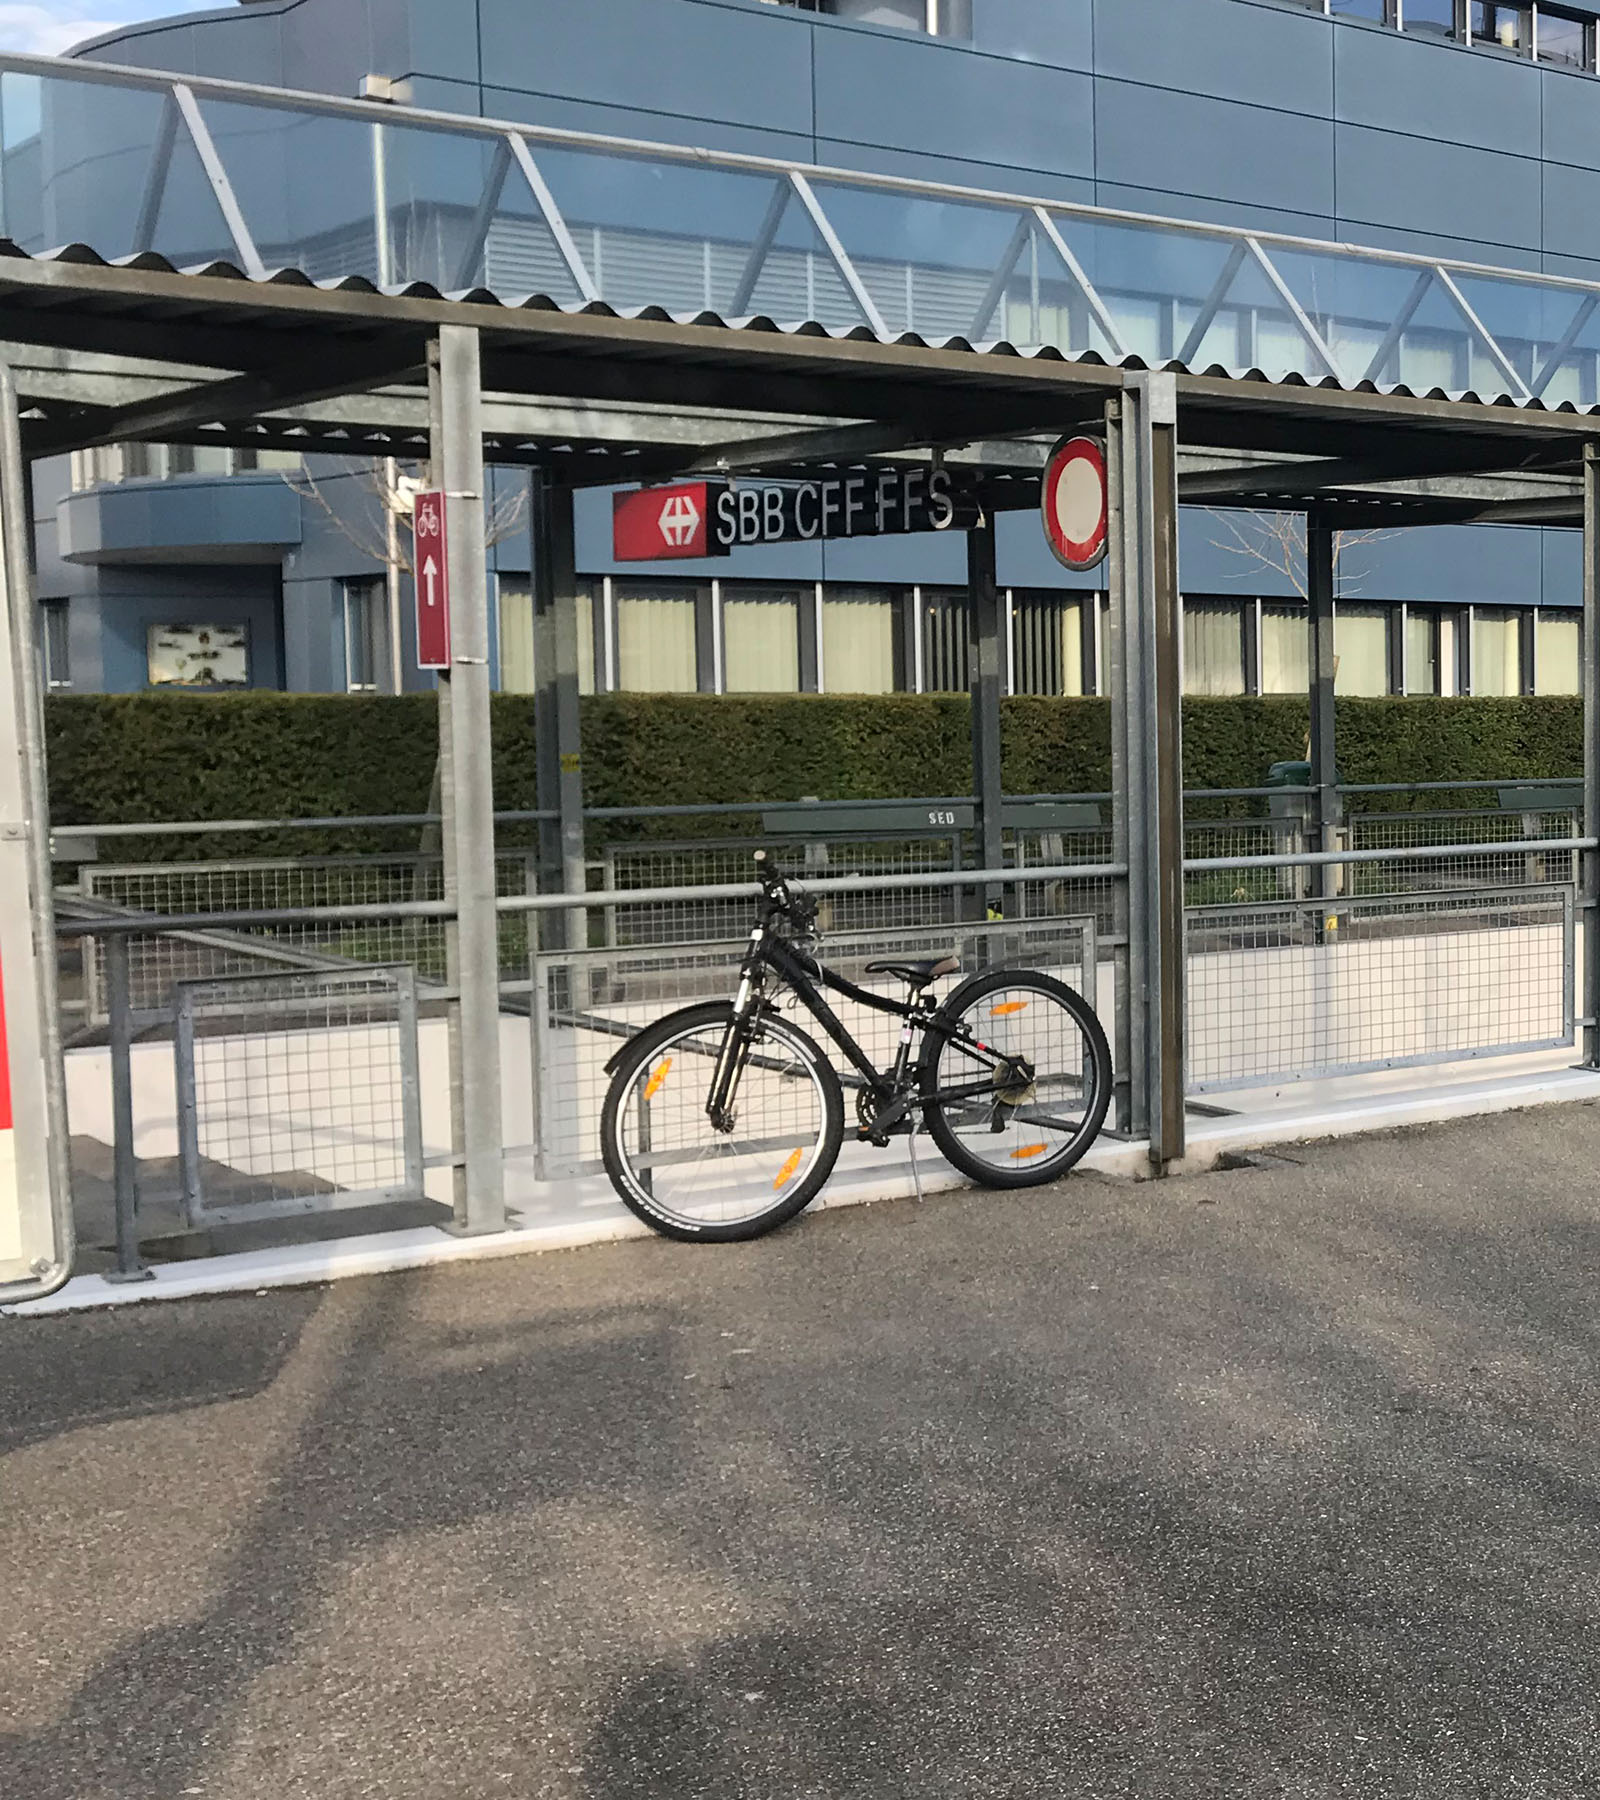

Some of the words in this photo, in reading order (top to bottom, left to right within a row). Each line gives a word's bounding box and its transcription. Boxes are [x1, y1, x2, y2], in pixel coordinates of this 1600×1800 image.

[717, 487, 785, 545] SBB
[795, 478, 865, 538] CFF
[877, 469, 954, 532] FFS
